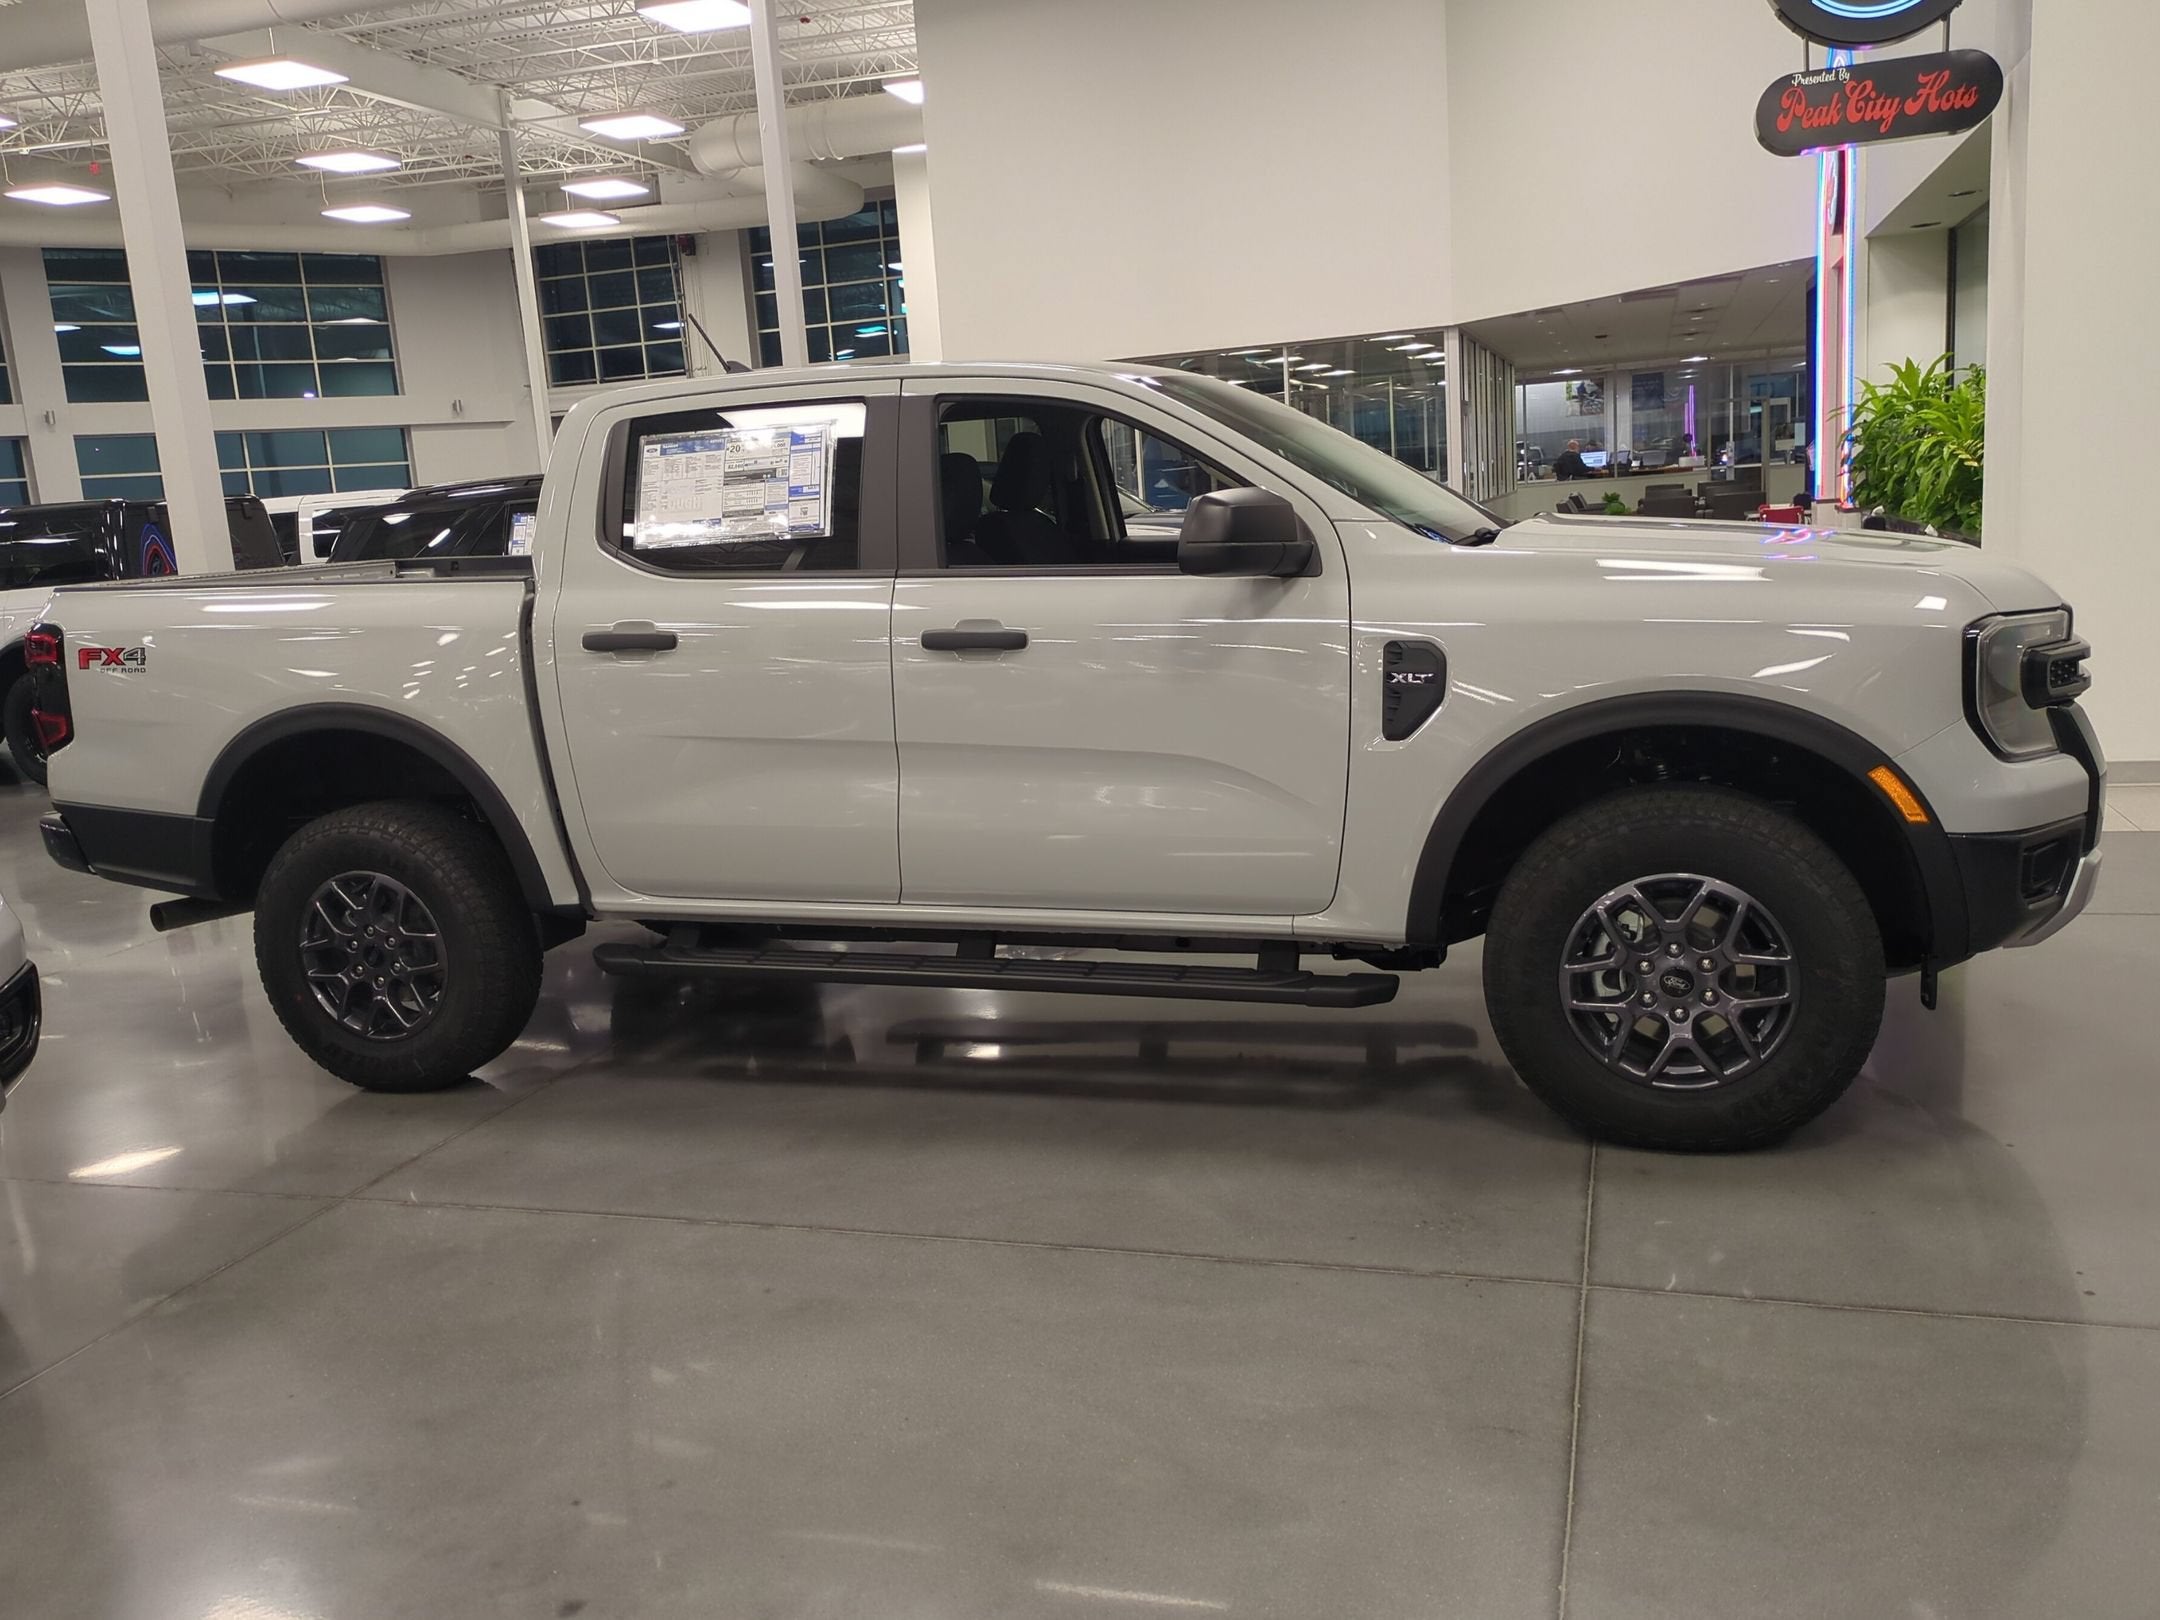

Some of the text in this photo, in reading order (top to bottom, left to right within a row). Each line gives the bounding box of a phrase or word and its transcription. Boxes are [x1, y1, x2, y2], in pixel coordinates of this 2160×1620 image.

[1791, 67, 1850, 87] Presented By
[1776, 69, 1979, 134] Peak City Hots
[78, 647, 146, 670] FX4
[1390, 672, 1434, 684] XLT
[1665, 976, 1689, 990] Ford
